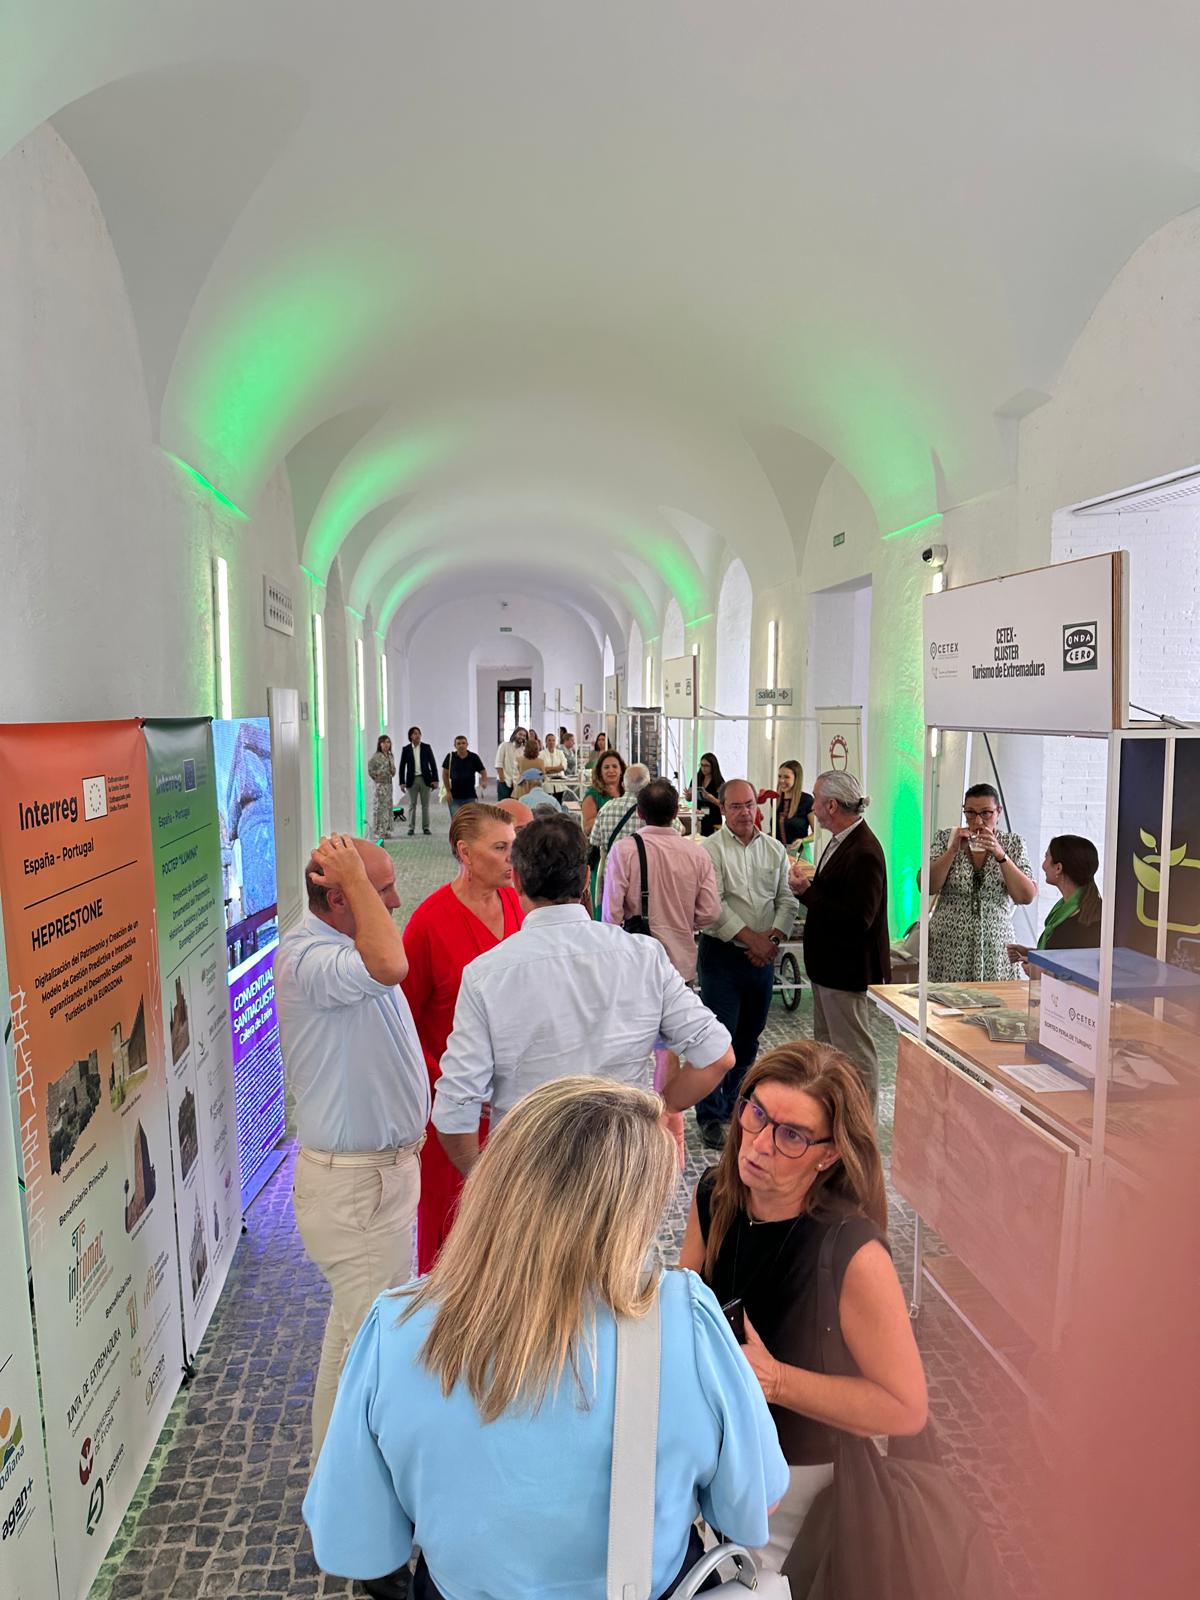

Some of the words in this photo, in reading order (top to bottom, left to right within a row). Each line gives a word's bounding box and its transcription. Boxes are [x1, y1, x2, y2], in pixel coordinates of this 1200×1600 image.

[938, 642, 959, 654] CETEX
[1068, 633, 1092, 644] ONDA
[1069, 649, 1091, 661] CERO
[972, 664, 994, 679] Turismo
[995, 664, 1003, 679] de
[1003, 660, 1045, 678] Extremadura
[19, 797, 78, 831] Interreg
[24, 852, 55, 876] España
[62, 837, 94, 861] Portugal
[31, 898, 104, 951] HEPRESTONE
[35, 958, 71, 989] Digitalización
[71, 952, 80, 967] del
[80, 938, 105, 960] Patrimonio
[109, 927, 127, 943] Creación
[127, 923, 134, 936] de
[133, 920, 139, 930] un
[41, 983, 62, 1004] Modelo
[62, 978, 70, 990] de
[70, 966, 89, 984] Gestión
[89, 952, 111, 971] Predictiva
[115, 936, 137, 956] Interactiva
[49, 987, 83, 1018] garantizando
[83, 982, 89, 993] el
[89, 968, 112, 989] Desarrollo
[111, 954, 133, 974] Sostenible
[64, 1001, 87, 1023] Turístico
[87, 995, 93, 1007] de
[93, 992, 99, 1003] la
[1076, 1013, 1096, 1028] CETEX
[59, 1187, 88, 1226] Beneficiario
[88, 1161, 108, 1191] Principal
[66, 1394, 82, 1430] JUNTA
[82, 1377, 89, 1399] DE
[89, 1327, 122, 1386] EXTREMADURA
